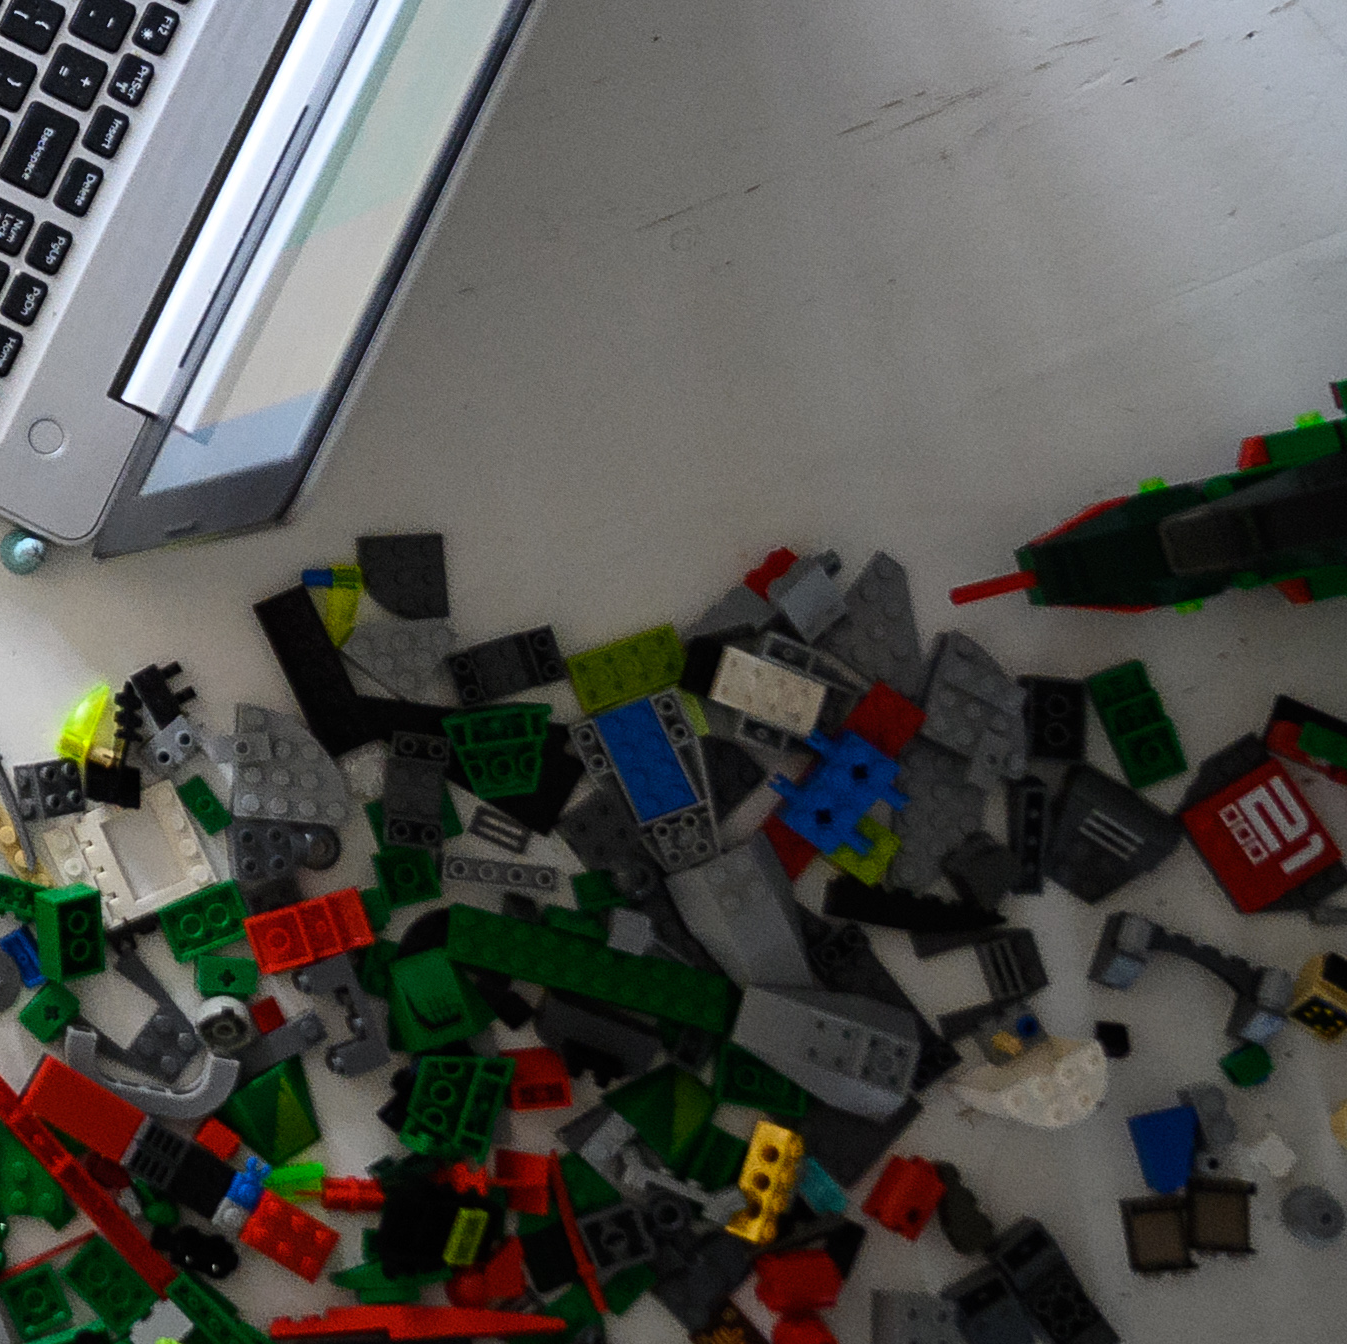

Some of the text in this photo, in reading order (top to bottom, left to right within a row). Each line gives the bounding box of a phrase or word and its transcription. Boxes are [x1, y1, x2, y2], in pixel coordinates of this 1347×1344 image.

[156, 15, 174, 36] F12
[126, 64, 150, 100] PrtScr
[100, 118, 122, 149] Insert
[20, 126, 54, 180] Backspace
[73, 172, 97, 206] Delete
[5, 218, 24, 243] Num
[44, 235, 66, 265] PgUp
[19, 286, 41, 316] PgDn
